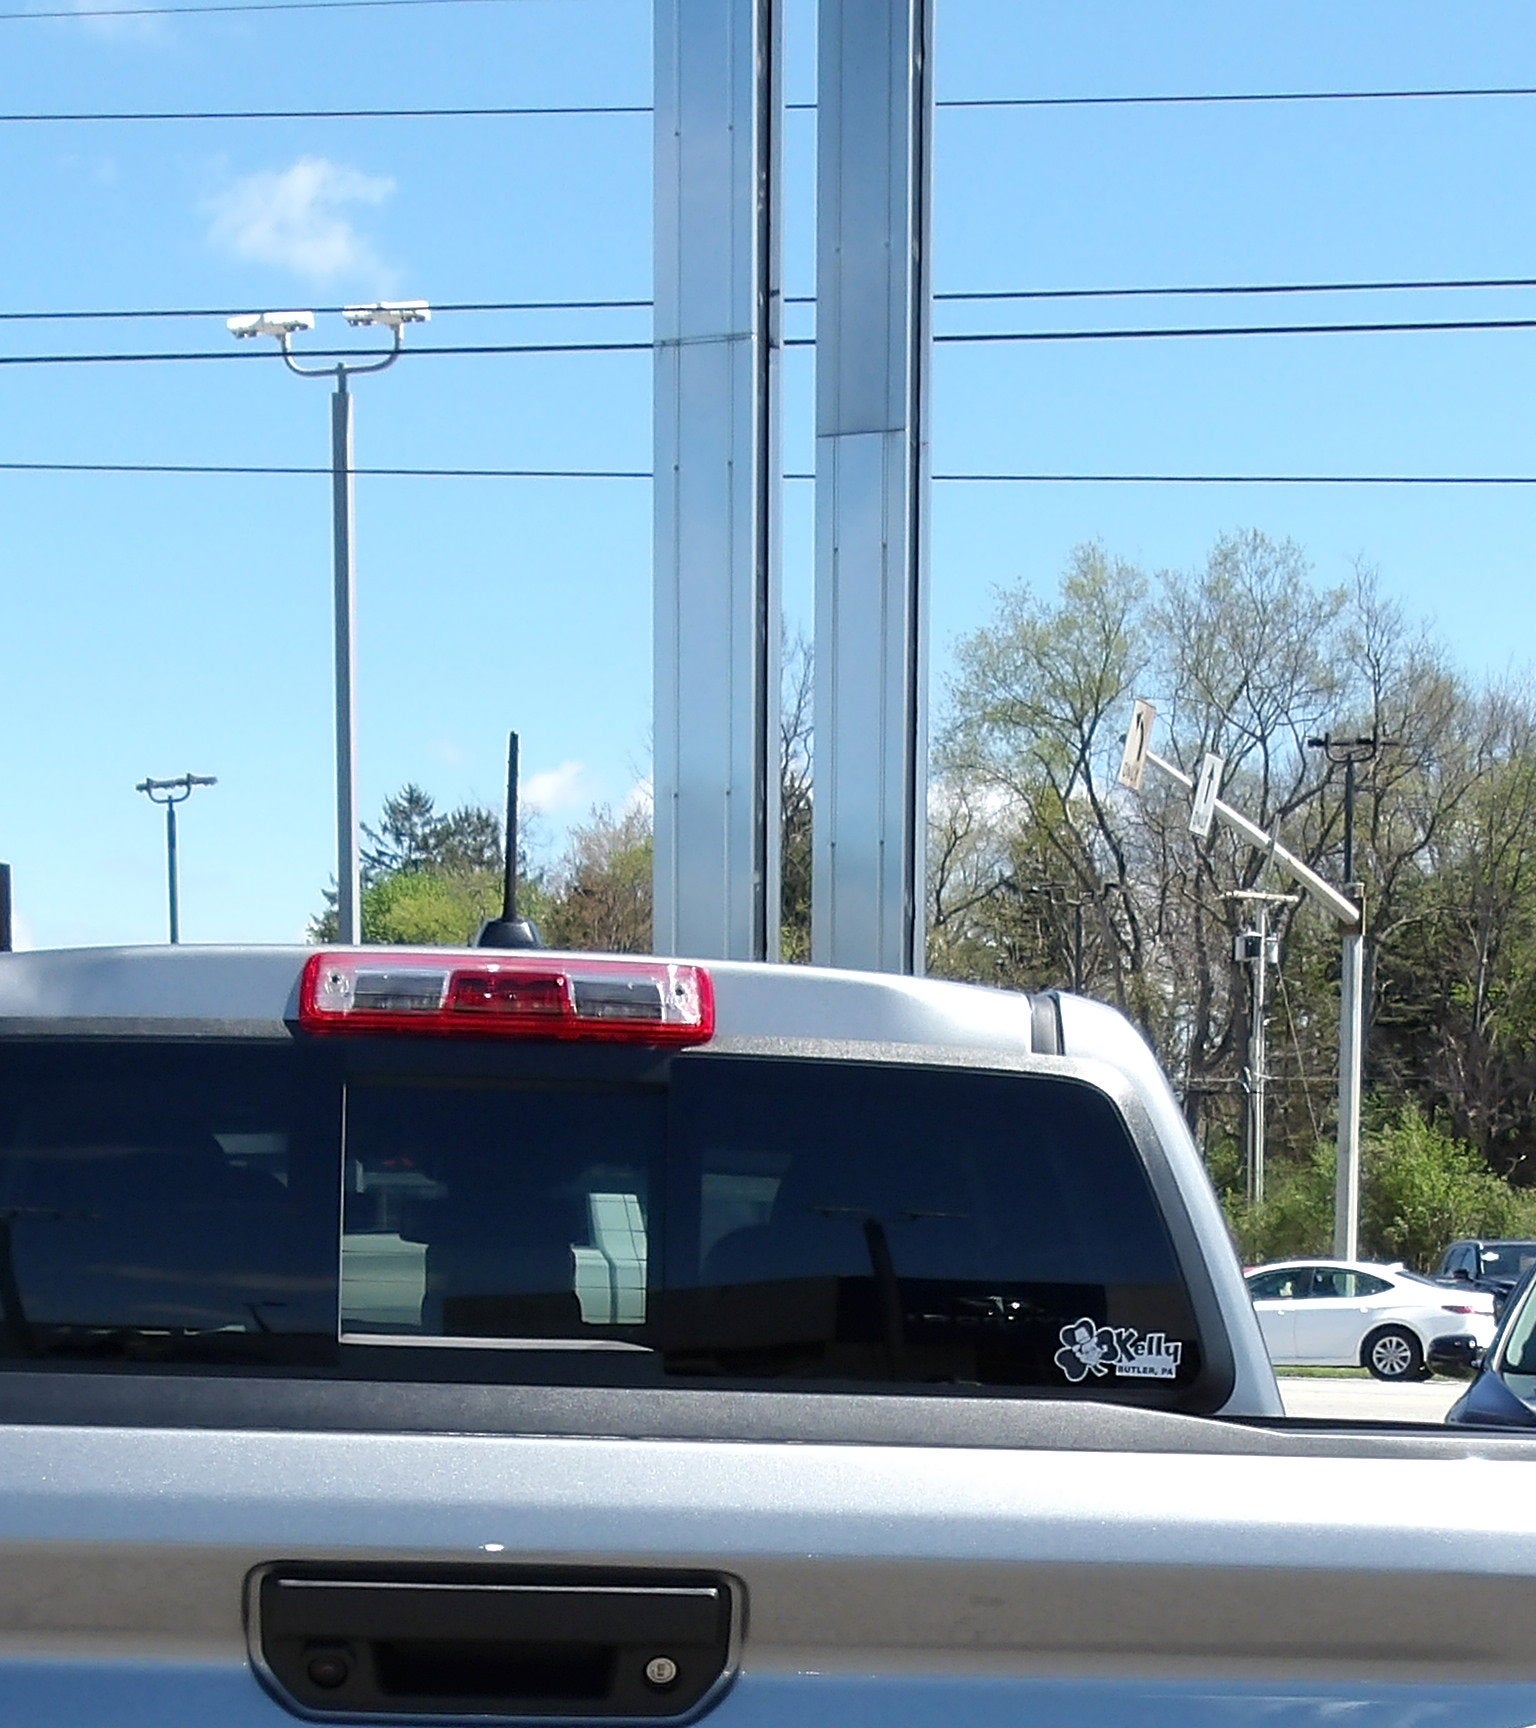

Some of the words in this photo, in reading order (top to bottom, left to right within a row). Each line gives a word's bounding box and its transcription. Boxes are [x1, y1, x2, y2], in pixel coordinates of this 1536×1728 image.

[1114, 1330, 1180, 1363] Kelly
[1118, 1366, 1158, 1376] BUTLER,
[1161, 1367, 1174, 1376] PA
